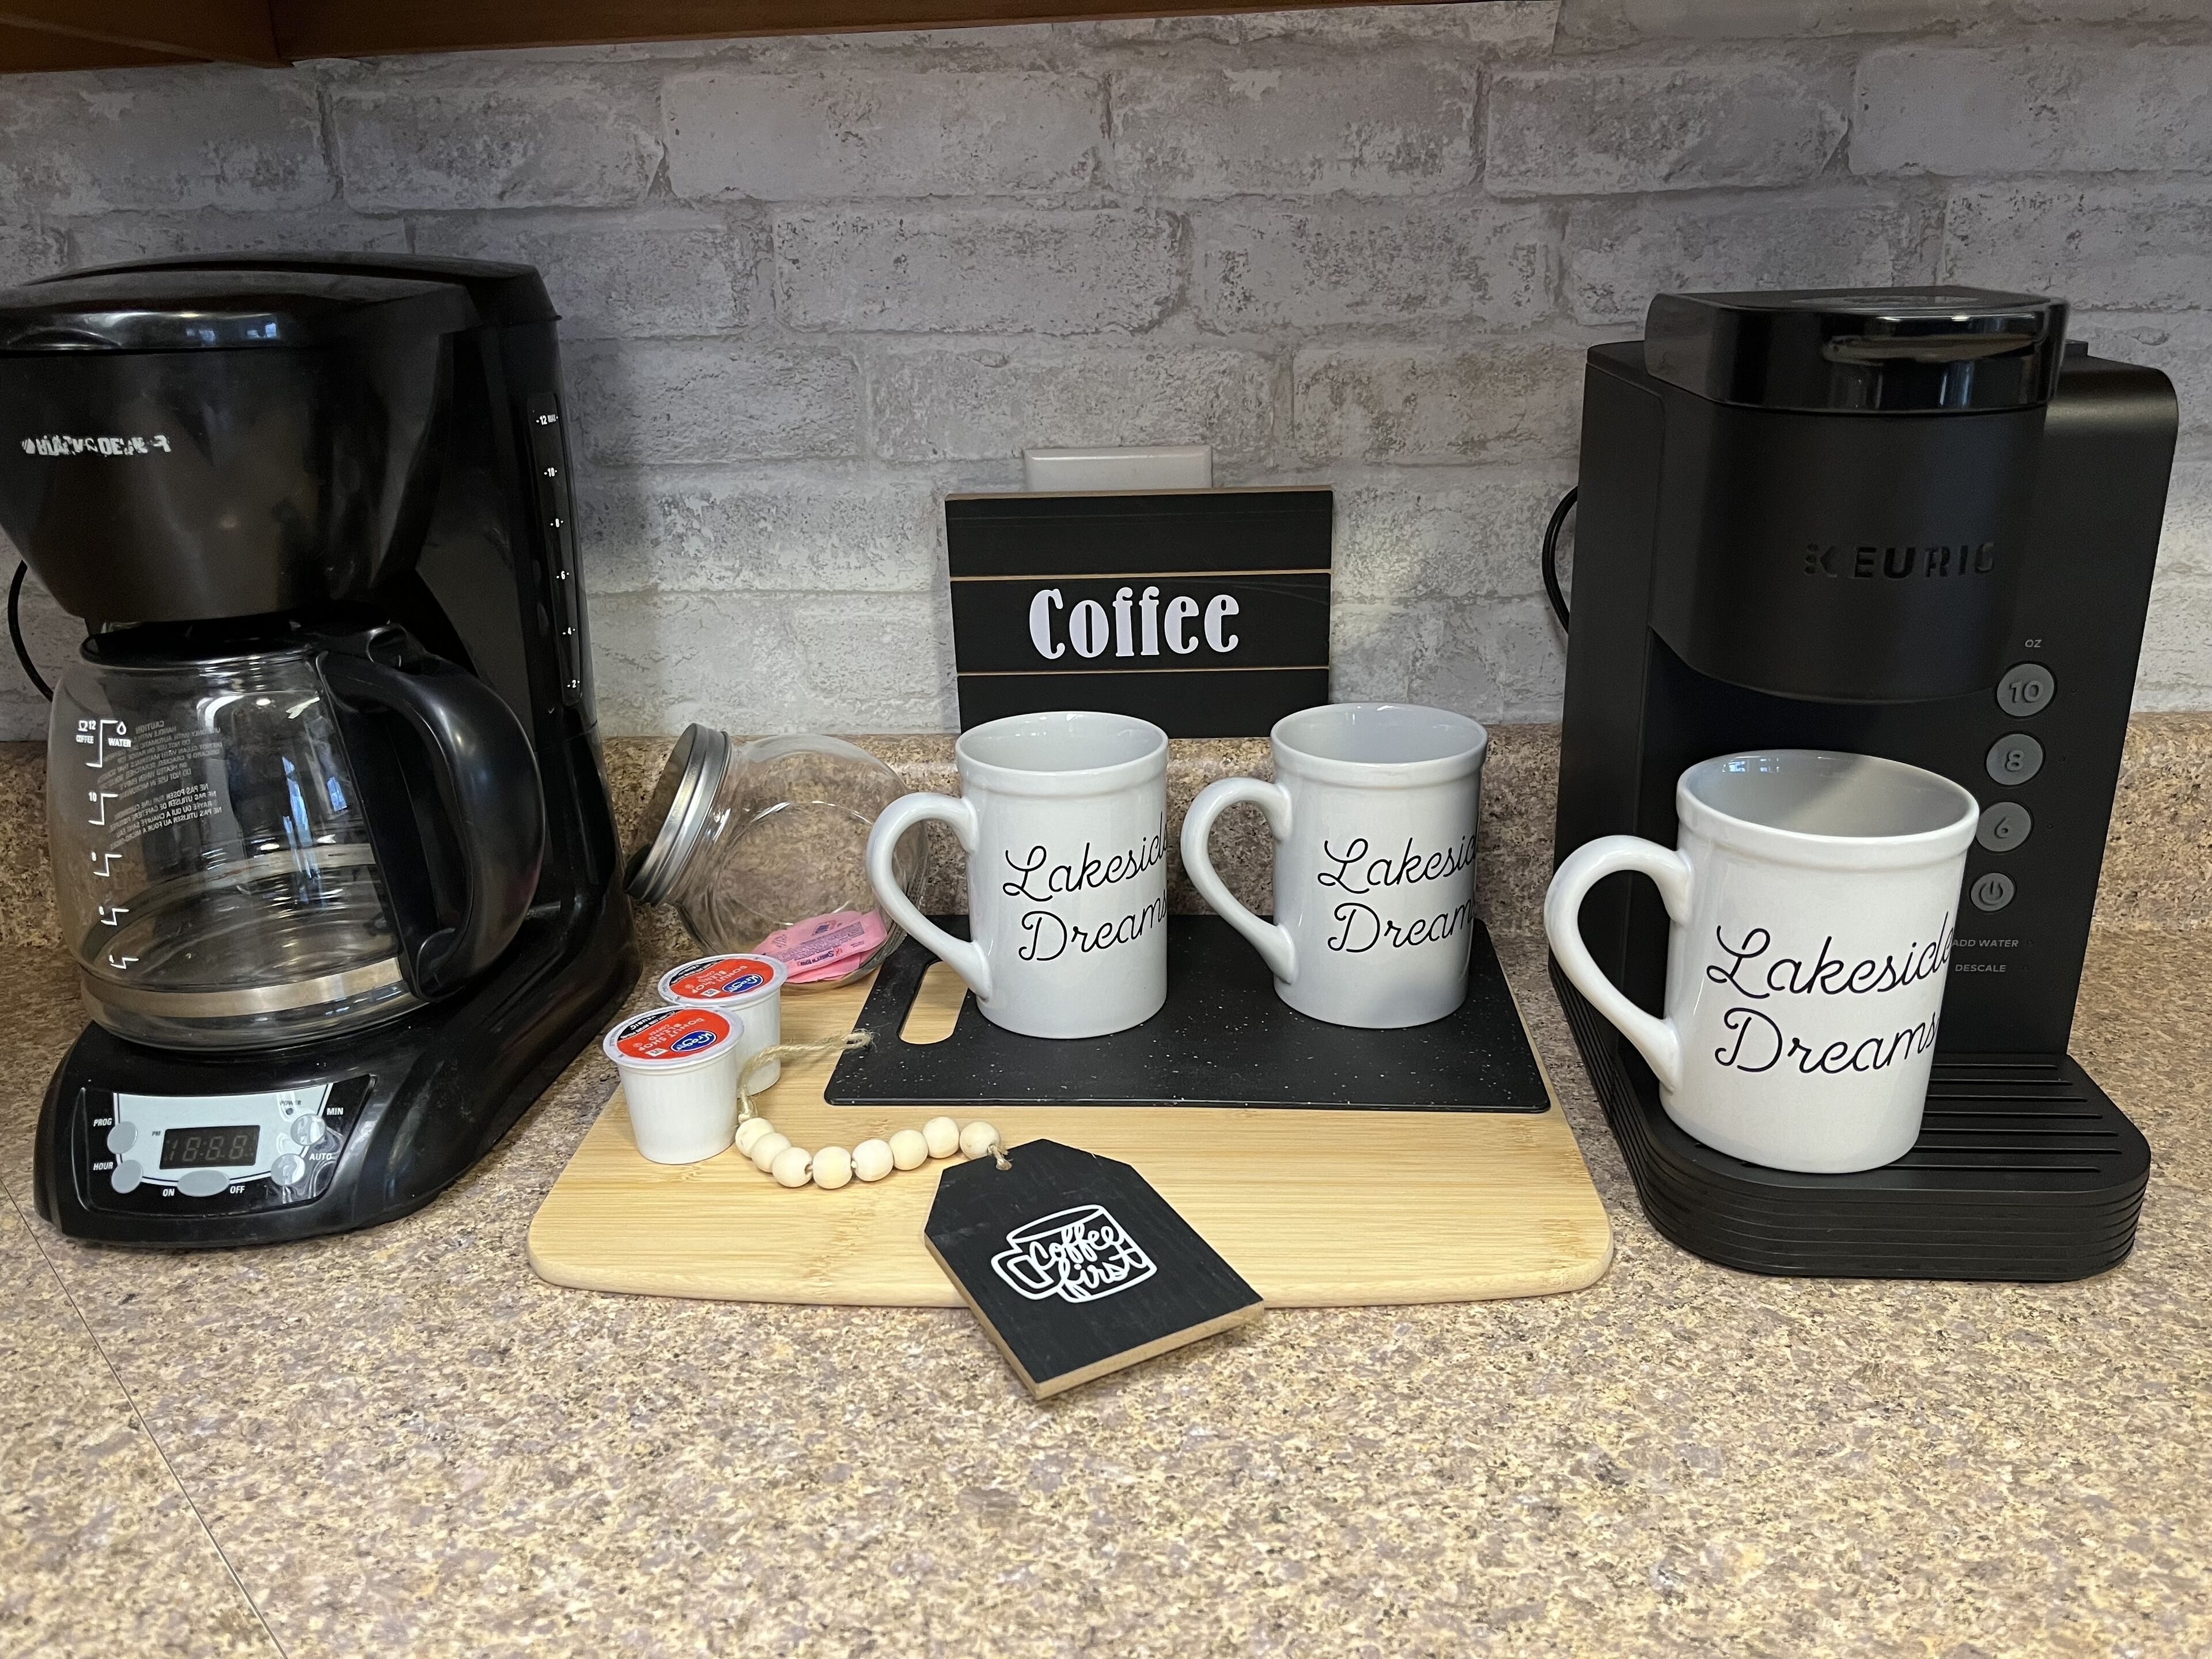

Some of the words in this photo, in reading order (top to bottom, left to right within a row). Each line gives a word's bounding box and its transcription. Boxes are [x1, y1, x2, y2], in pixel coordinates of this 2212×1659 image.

[539, 414, 548, 425] 12
[547, 467, 555, 478] 10
[555, 518, 560, 528] 8
[1804, 541, 1995, 579] KEURIG
[560, 570, 566, 580] 6
[1029, 586, 1240, 660] Coffee
[567, 627, 572, 635] 4
[571, 679, 577, 688] 2
[2009, 680, 2044, 703] 10
[88, 719, 97, 732] 12
[76, 734, 94, 745] COFFEE
[108, 737, 132, 748] WATER
[2005, 749, 2024, 772] 8
[89, 791, 97, 803] 10
[1995, 816, 2011, 839] 6
[91, 851, 97, 862] 8
[1328, 899, 1475, 953] Dream
[1951, 939, 1976, 947] ADD
[1979, 939, 2019, 948] WATER
[1706, 911, 1954, 999] Lakeside
[1955, 964, 2006, 972] DESCALE
[676, 1033, 712, 1051] Kroger
[1715, 1007, 1940, 1073] Dreams
[327, 1107, 344, 1116] MIN
[93, 1117, 112, 1127] PROG
[309, 1152, 332, 1161] AUTO
[93, 1161, 113, 1171] HOUR
[162, 1188, 175, 1198] ON
[229, 1184, 245, 1195] OFF
